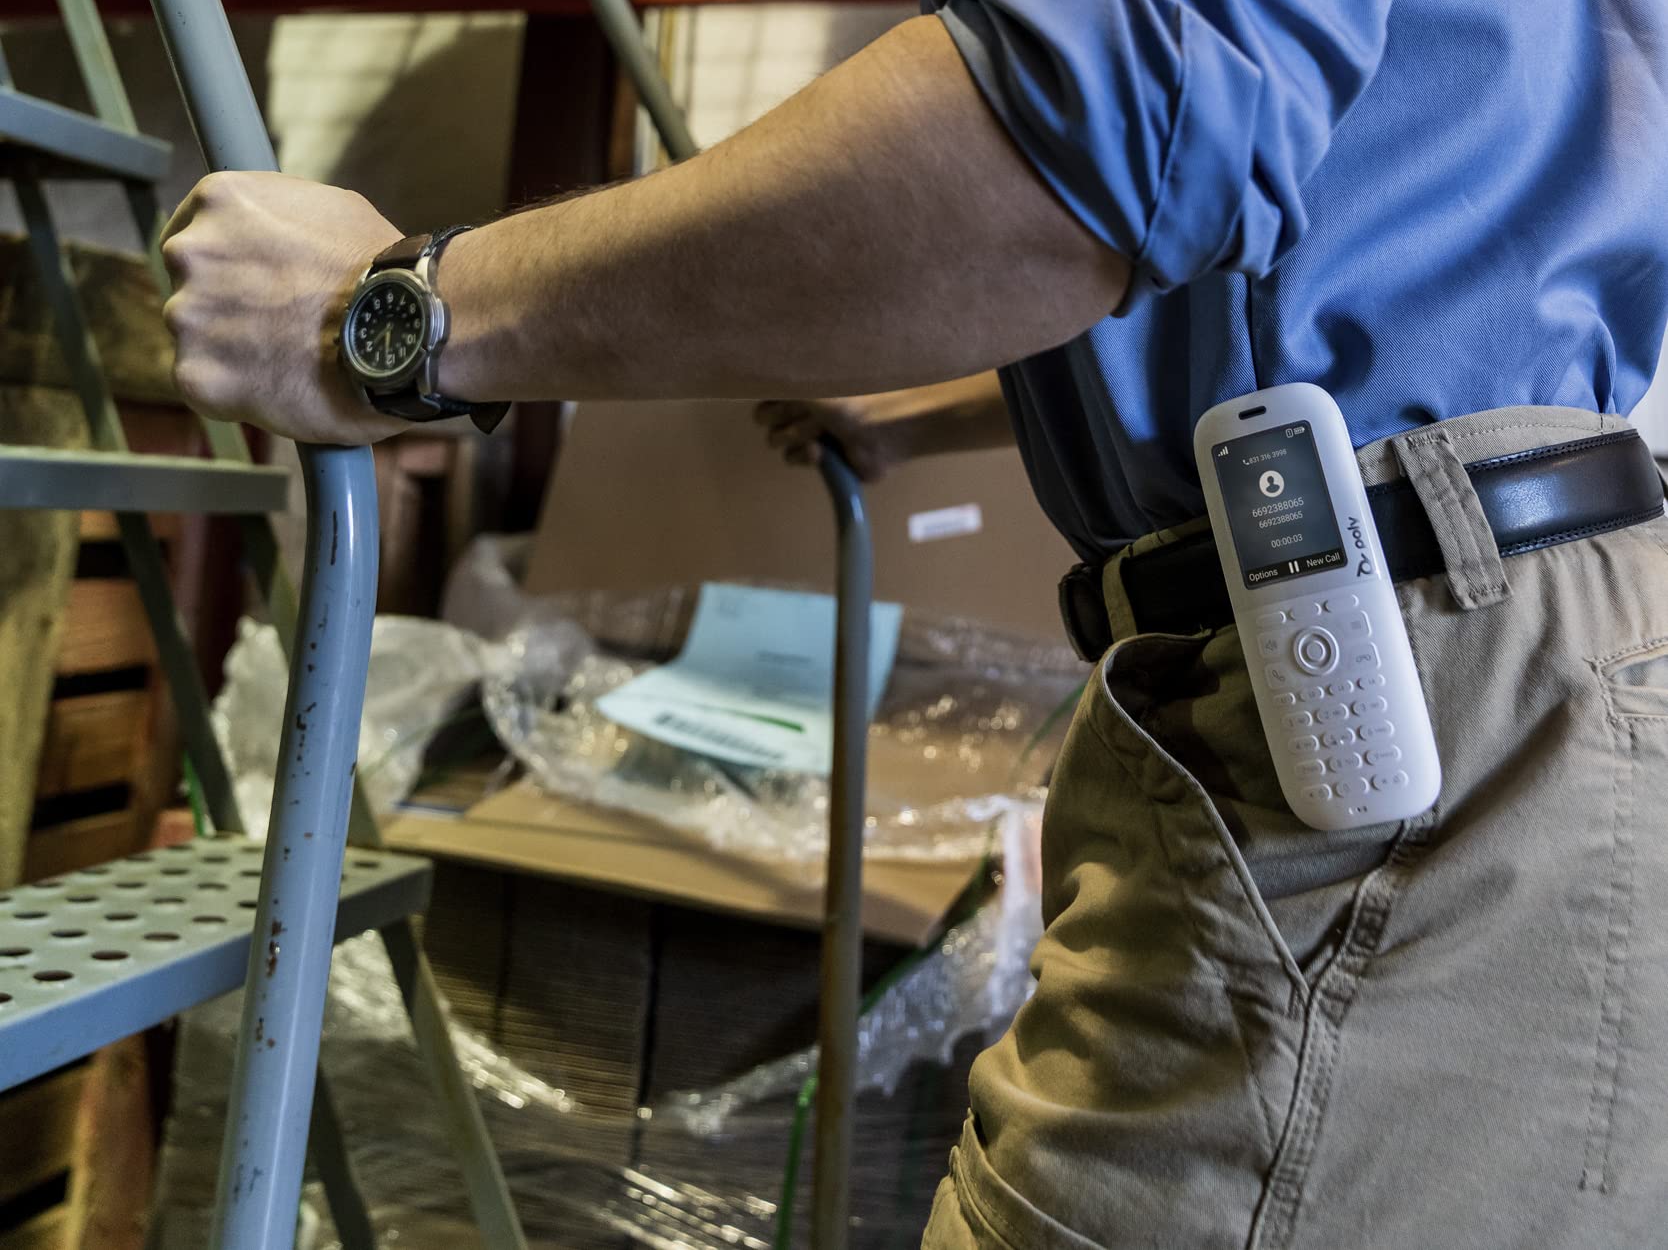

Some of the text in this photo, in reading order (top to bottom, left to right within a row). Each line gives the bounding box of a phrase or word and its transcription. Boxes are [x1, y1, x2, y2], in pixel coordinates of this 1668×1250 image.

[1252, 497, 1304, 518] 6692388065
[1347, 516, 1366, 549] poly
[1271, 534, 1303, 548] 00:00:03
[1306, 552, 1341, 568] New Call
[1249, 570, 1278, 582] Options
